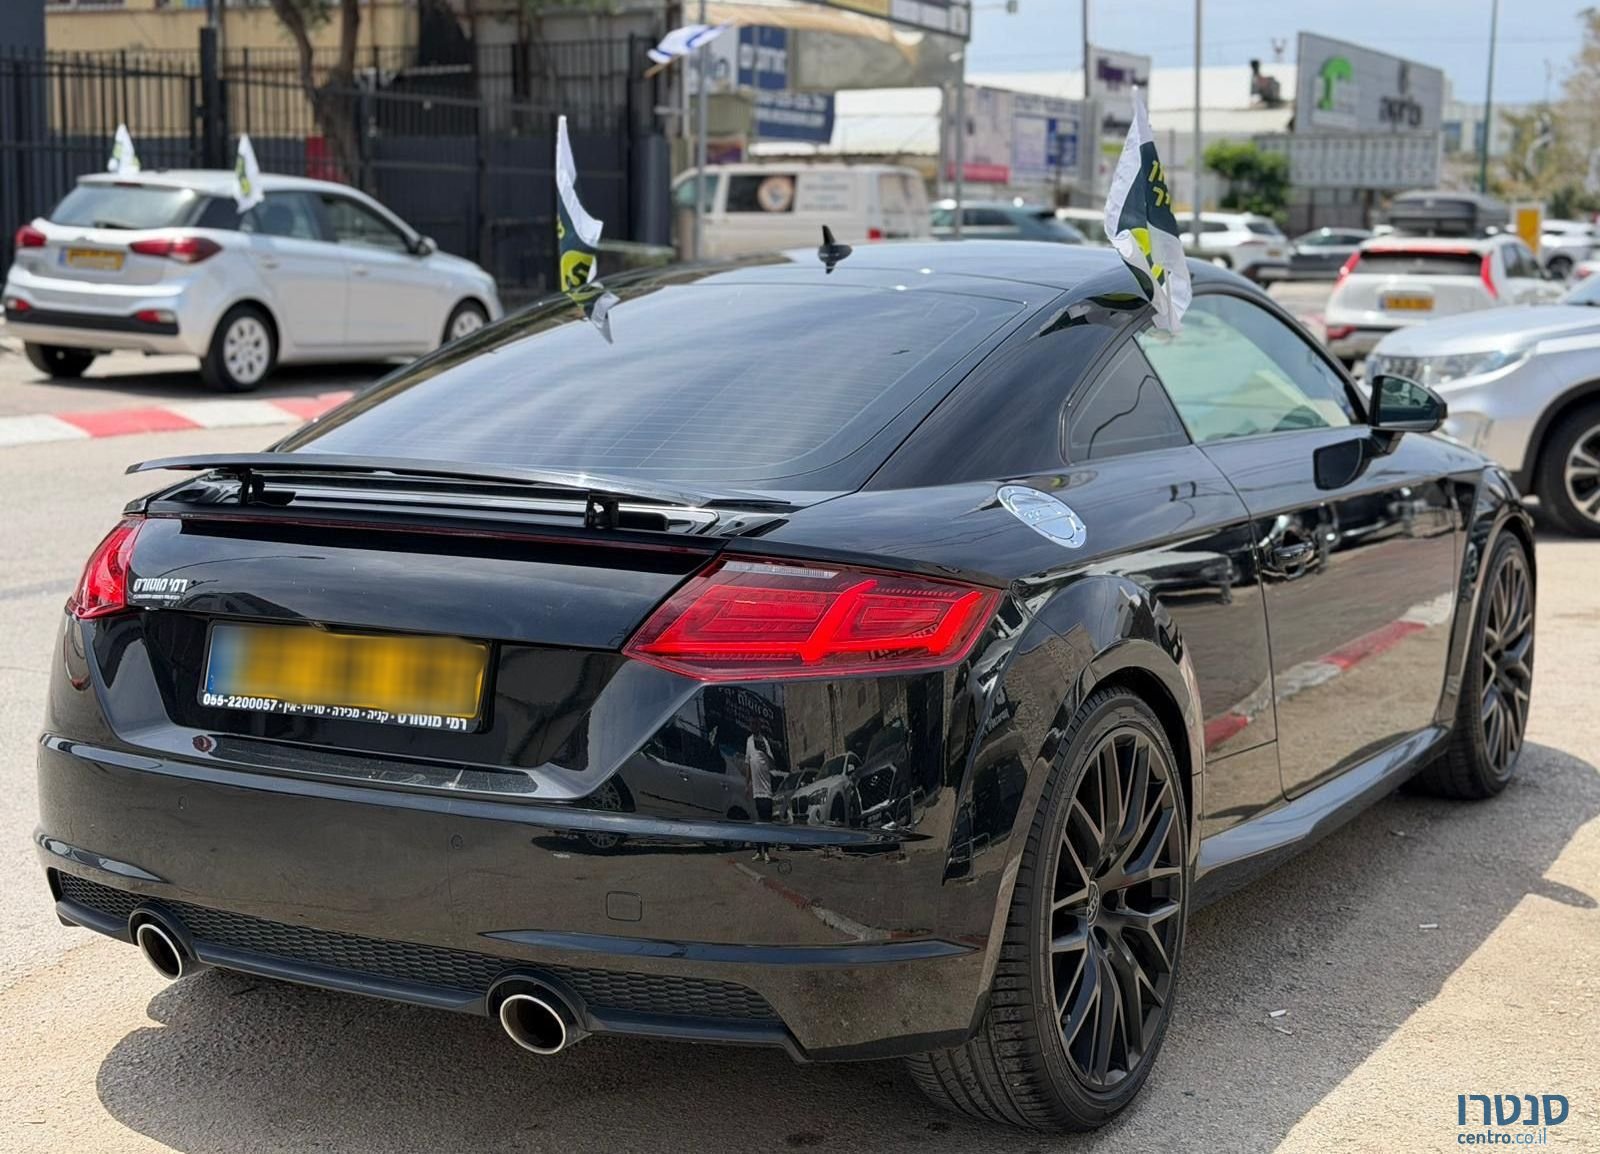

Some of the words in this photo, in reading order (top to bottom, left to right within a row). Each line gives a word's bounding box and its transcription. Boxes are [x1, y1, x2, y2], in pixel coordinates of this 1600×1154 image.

[169, 578, 188, 592] רמי
[203, 693, 277, 711] 055-2200057
[332, 706, 360, 719] מכירה
[367, 709, 390, 724] קניה
[446, 717, 467, 731] רמי
